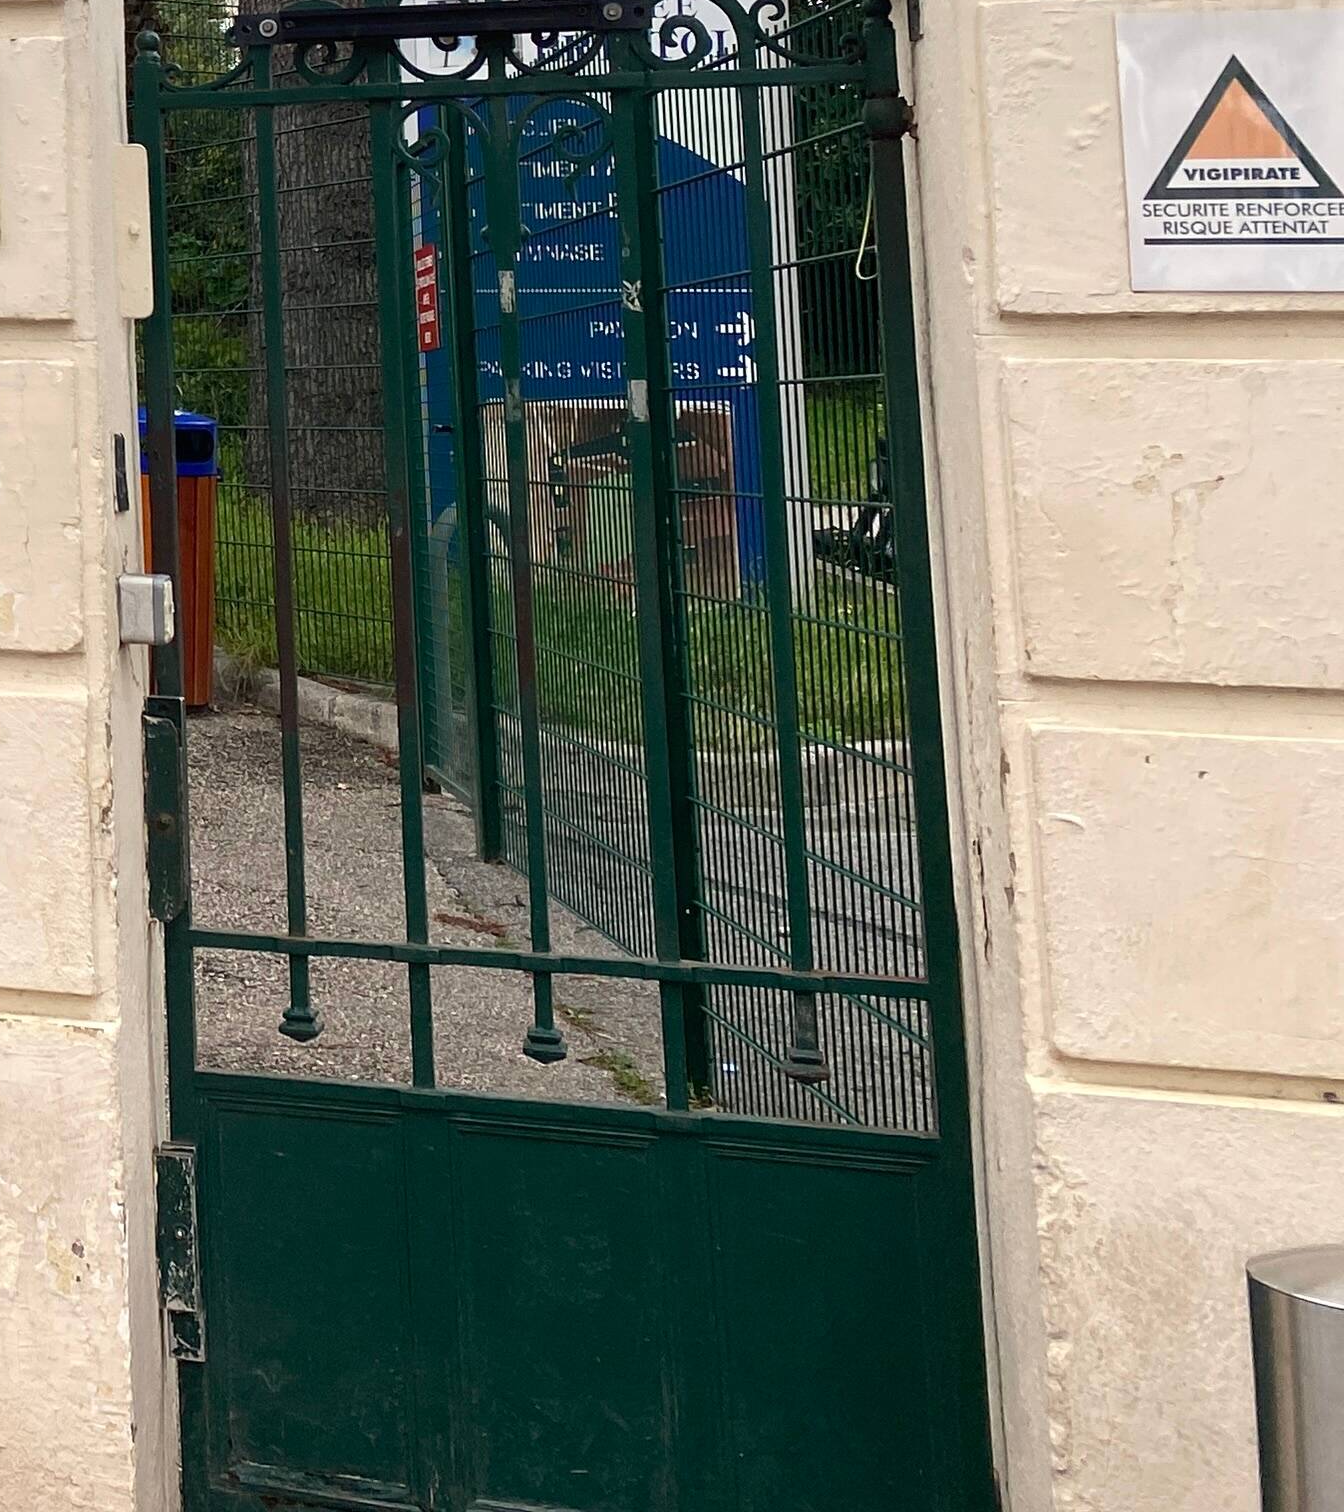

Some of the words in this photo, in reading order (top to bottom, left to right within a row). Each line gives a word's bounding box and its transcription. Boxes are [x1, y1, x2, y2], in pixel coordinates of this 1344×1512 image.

[1183, 167, 1300, 181] VIGIPIRATE
[1143, 202, 1229, 218] SECURITE
[1163, 220, 1233, 235] RISQUE
[1239, 220, 1329, 234] ATTENTAT
